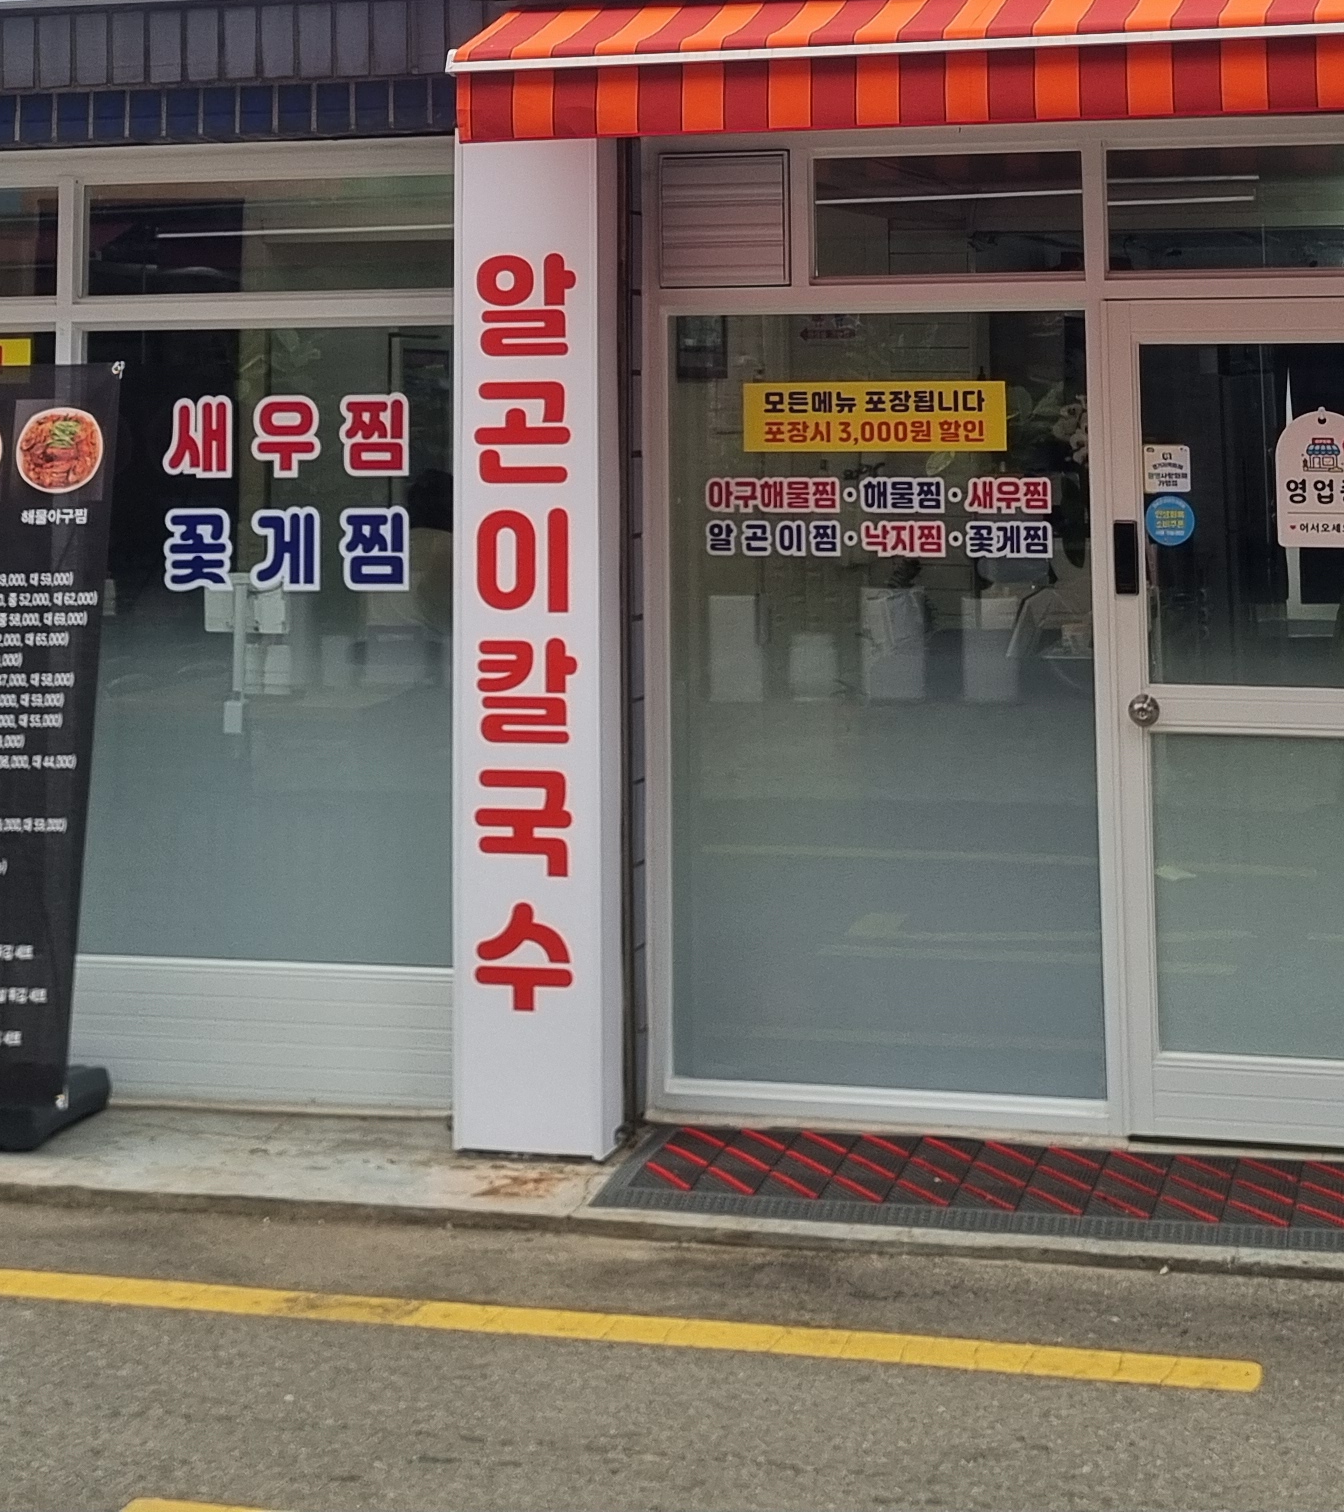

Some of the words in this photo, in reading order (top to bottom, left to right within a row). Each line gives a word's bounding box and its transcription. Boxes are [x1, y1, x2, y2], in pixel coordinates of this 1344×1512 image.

[764, 390, 857, 414] 모든메뉴
[864, 389, 986, 413] 포장됩니다
[764, 421, 832, 444] 포장시
[838, 421, 932, 446] 3,000원
[938, 420, 986, 443] 할인
[21, 508, 88, 526] 해물아구찜
[474, 253, 578, 1012] 알곤이칼국수
